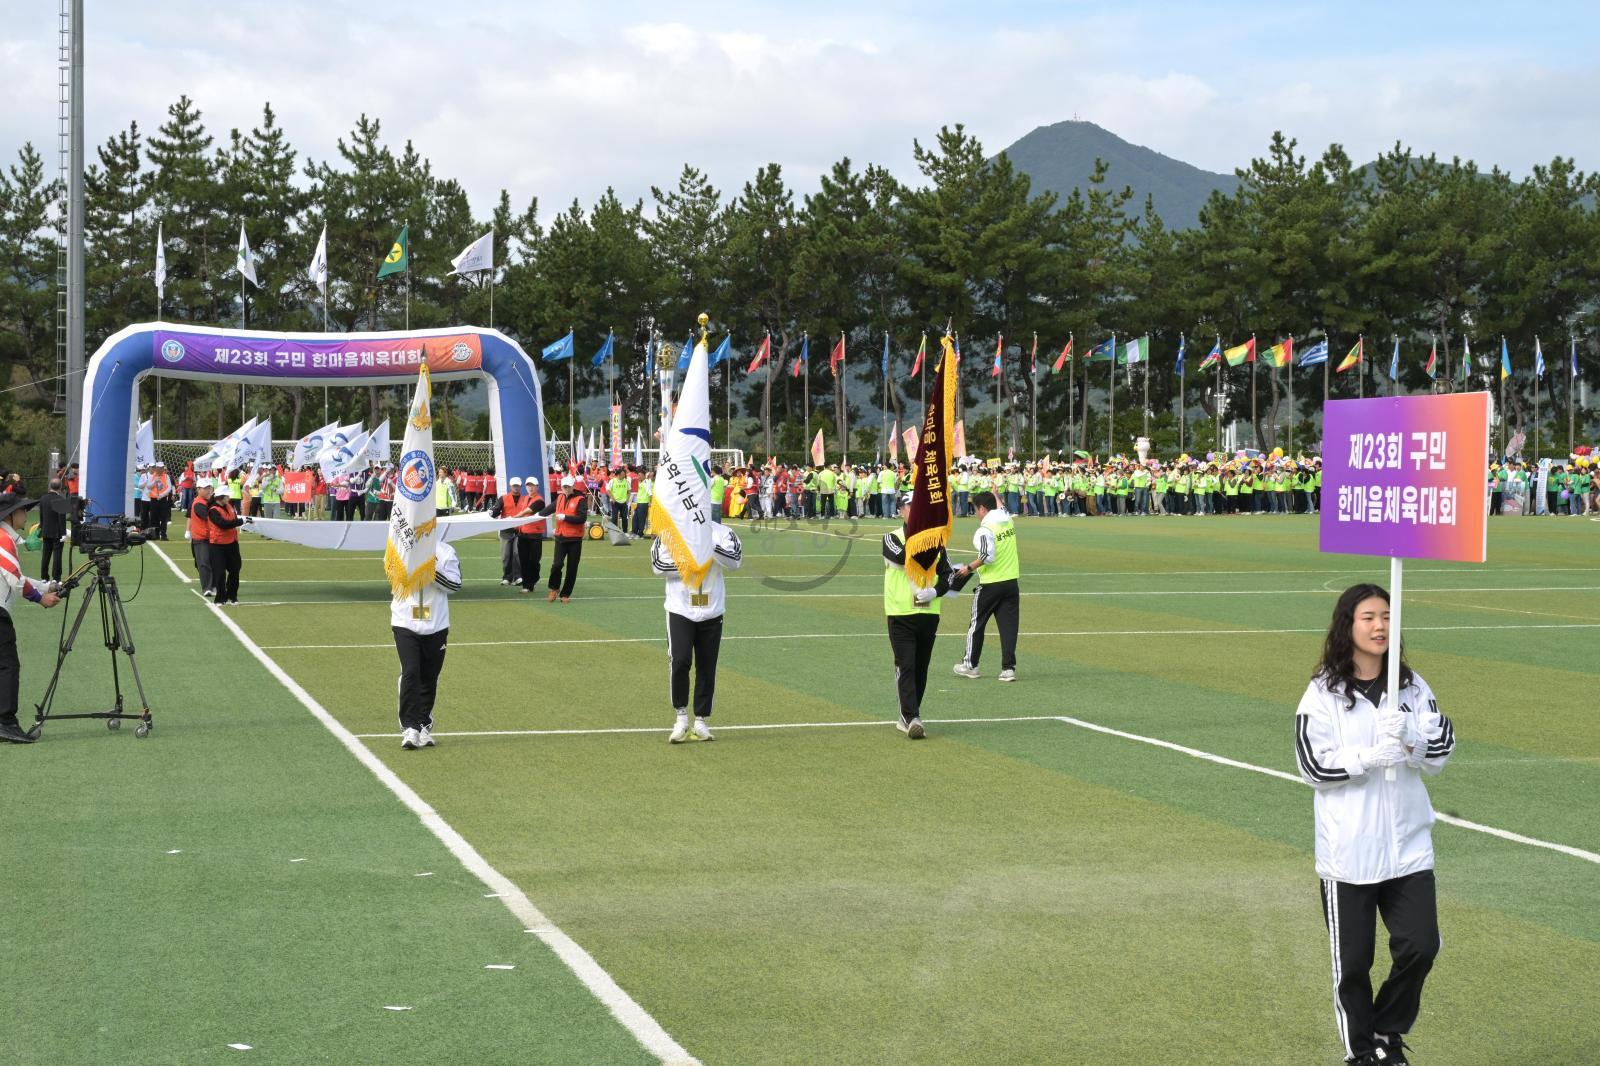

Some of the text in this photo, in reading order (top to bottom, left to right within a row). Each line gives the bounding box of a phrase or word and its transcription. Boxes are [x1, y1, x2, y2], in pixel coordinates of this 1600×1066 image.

[214, 348, 423, 368] 제23회 구민 한마음체육대회
[1348, 431, 1446, 470] 제23회 구민
[924, 450, 944, 505] 체육대회
[1338, 485, 1457, 526] 한마음체육대회
